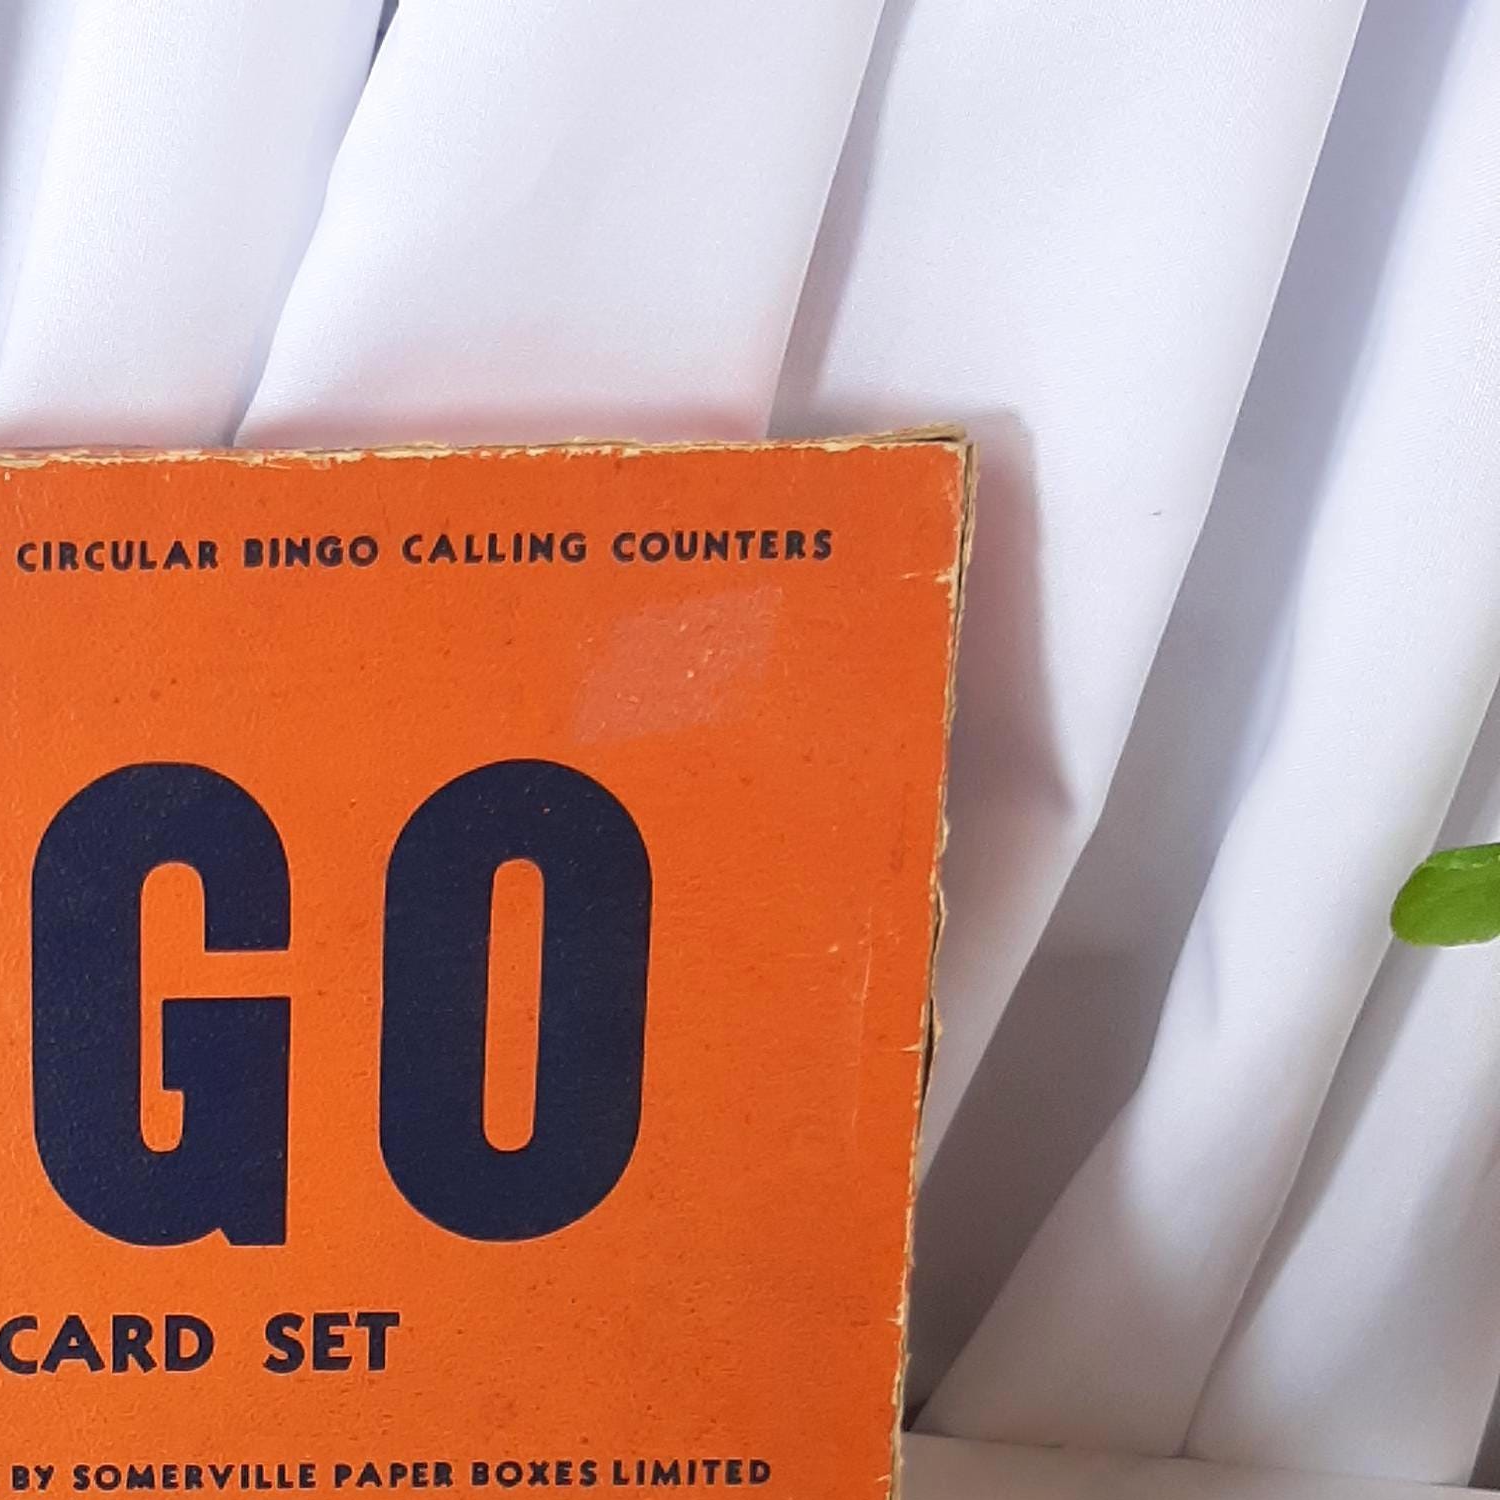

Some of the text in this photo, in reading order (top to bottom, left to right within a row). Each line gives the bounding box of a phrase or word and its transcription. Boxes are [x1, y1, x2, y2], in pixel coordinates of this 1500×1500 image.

[17, 541, 217, 572] CIRCULAR
[244, 536, 378, 568] BINGO
[402, 533, 586, 563] CALLING
[613, 530, 831, 562] COUNTERS
[263, 1312, 400, 1373] SET
[12, 1466, 53, 1490] BY
[73, 1464, 315, 1490] SOMERVILLE
[335, 1462, 452, 1488] PAPER
[472, 1460, 596, 1488] BOXES
[613, 1460, 770, 1485] LIMITED
